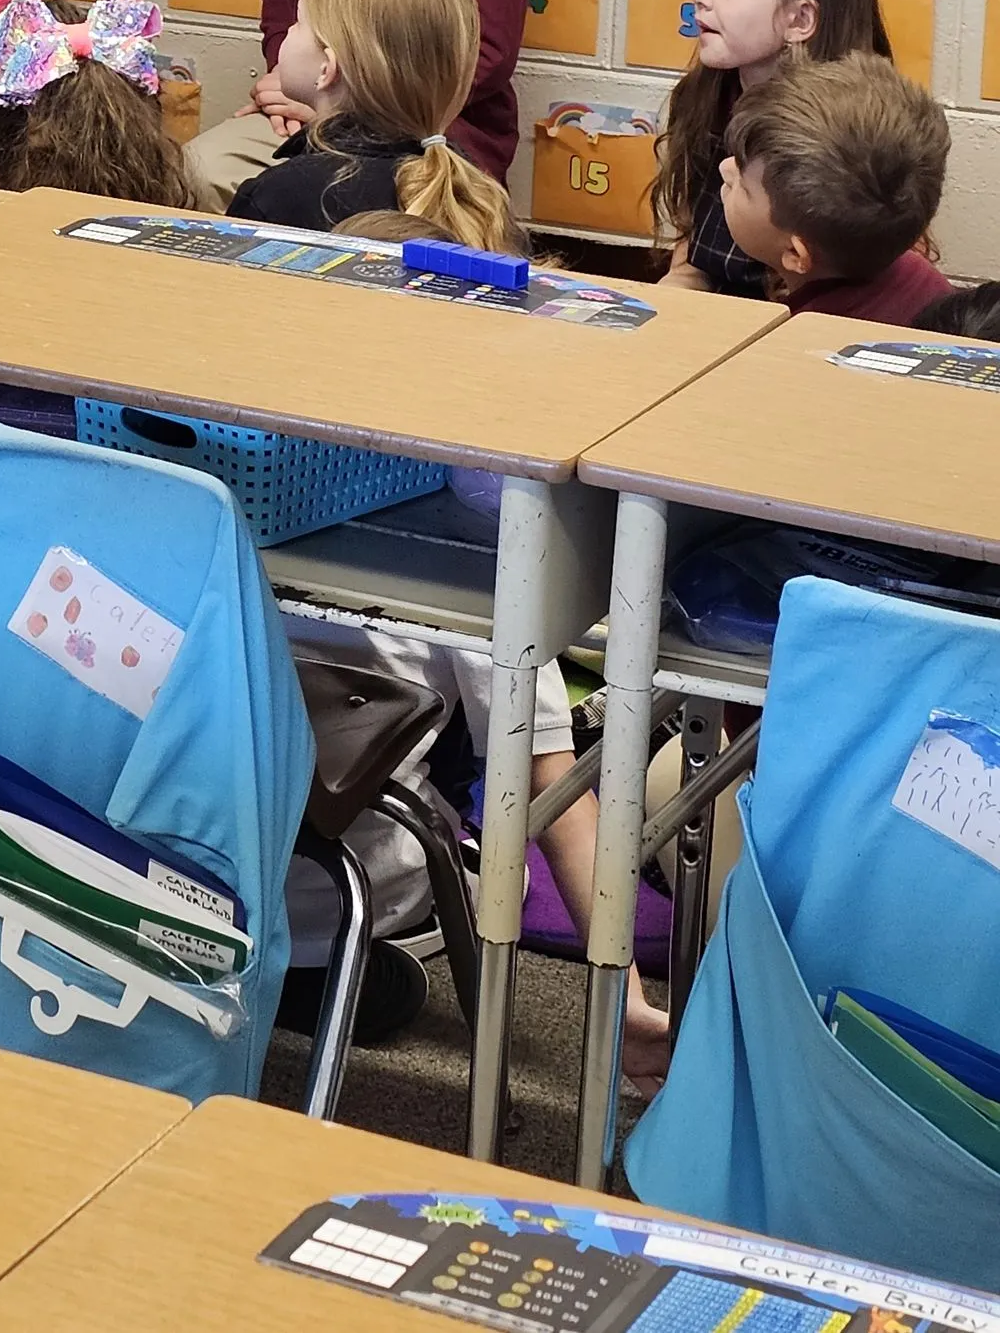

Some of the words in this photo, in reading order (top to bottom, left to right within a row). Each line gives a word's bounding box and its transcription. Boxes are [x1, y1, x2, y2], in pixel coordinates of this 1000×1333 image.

[568, 154, 610, 196] 15
[165, 875, 219, 905] CALETTE
[161, 929, 217, 951] CALETTE
[739, 1256, 860, 1295] Carter
[883, 1289, 990, 1332] Bailey
